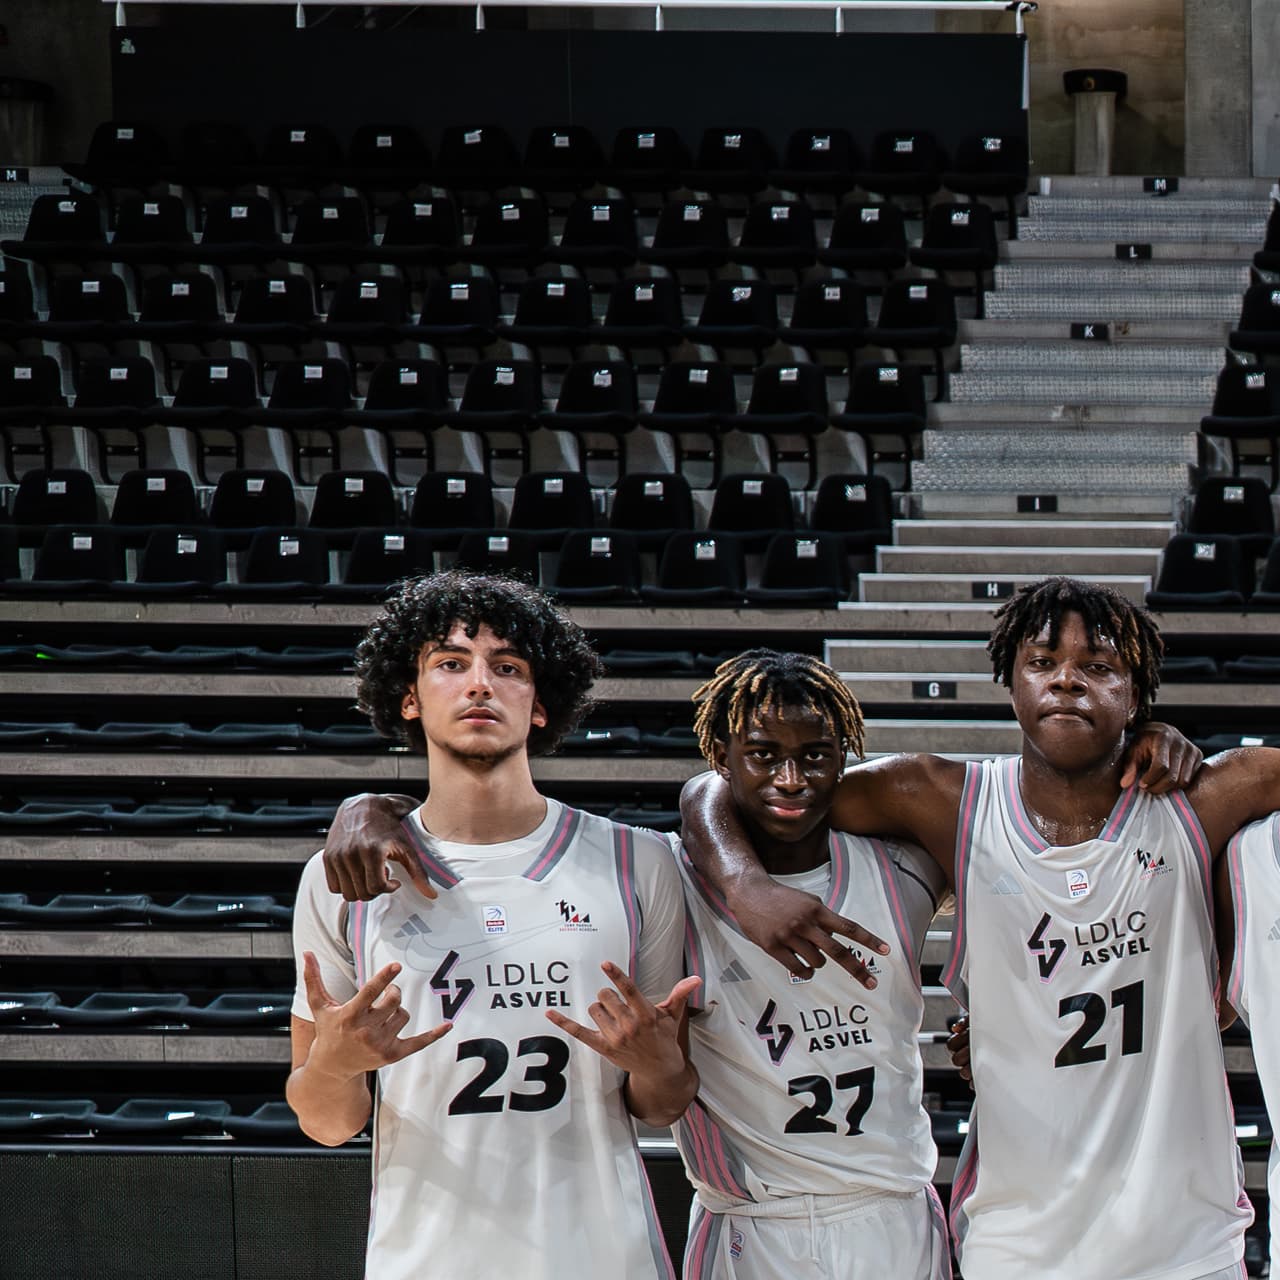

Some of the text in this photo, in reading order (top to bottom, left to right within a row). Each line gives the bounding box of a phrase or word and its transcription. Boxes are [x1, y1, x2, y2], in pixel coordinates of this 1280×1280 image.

[1084, 325, 1095, 338] K
[987, 583, 999, 597] H
[928, 682, 941, 698] G
[1075, 911, 1147, 947] LDLC
[1080, 936, 1151, 967] ASVEL
[486, 961, 570, 987] LDLC
[490, 990, 571, 1010] ASVEL
[799, 1004, 870, 1033] LDLC
[1054, 979, 1146, 1069] 21
[808, 1028, 873, 1053] ASVEL
[448, 1035, 571, 1116] 23
[784, 1066, 875, 1138] 27
